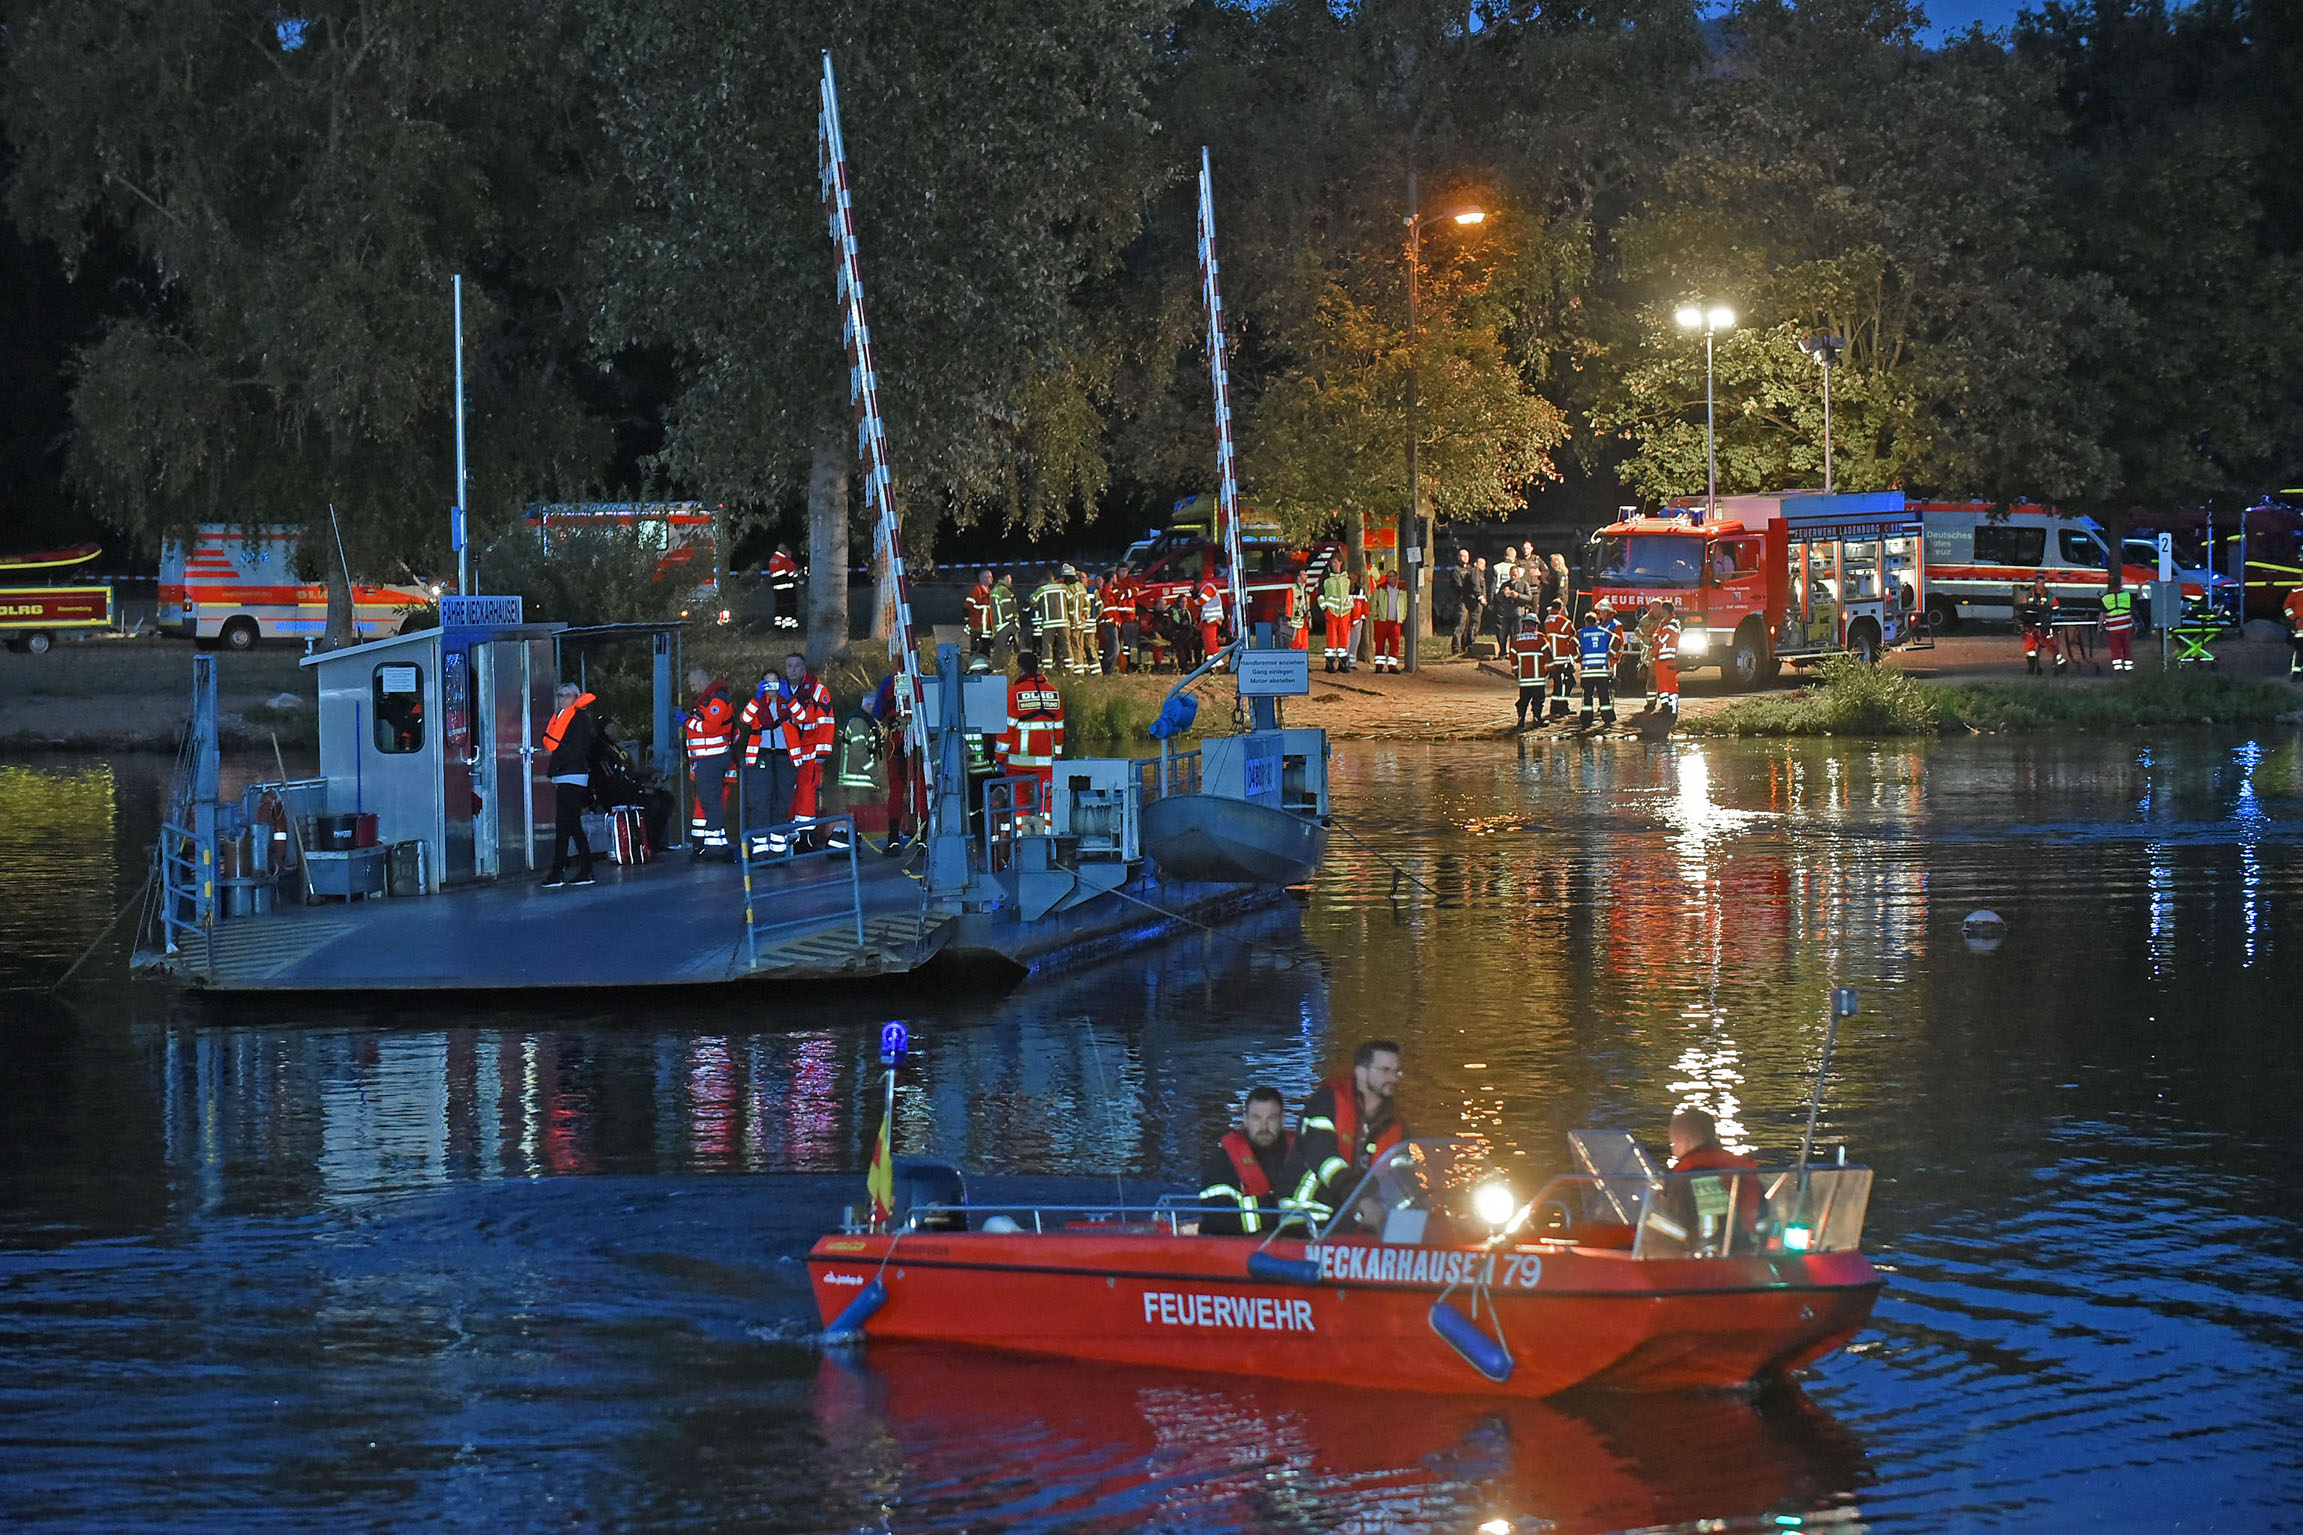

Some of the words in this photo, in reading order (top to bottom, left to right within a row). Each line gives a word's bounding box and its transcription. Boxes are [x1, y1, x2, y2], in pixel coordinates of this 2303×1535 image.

[1794, 526, 1837, 538] FEUERWEHR
[1840, 523, 1880, 535] LADENBURG
[1926, 531, 1973, 540] Deutsches
[1931, 540, 1952, 548] otes
[2161, 537, 2169, 552] 2
[1252, 668, 1268, 676] Gang
[1269, 668, 1294, 676] einlegen
[1504, 1253, 1542, 1288] 79
[1143, 1291, 1316, 1332] FEUERWEHR
